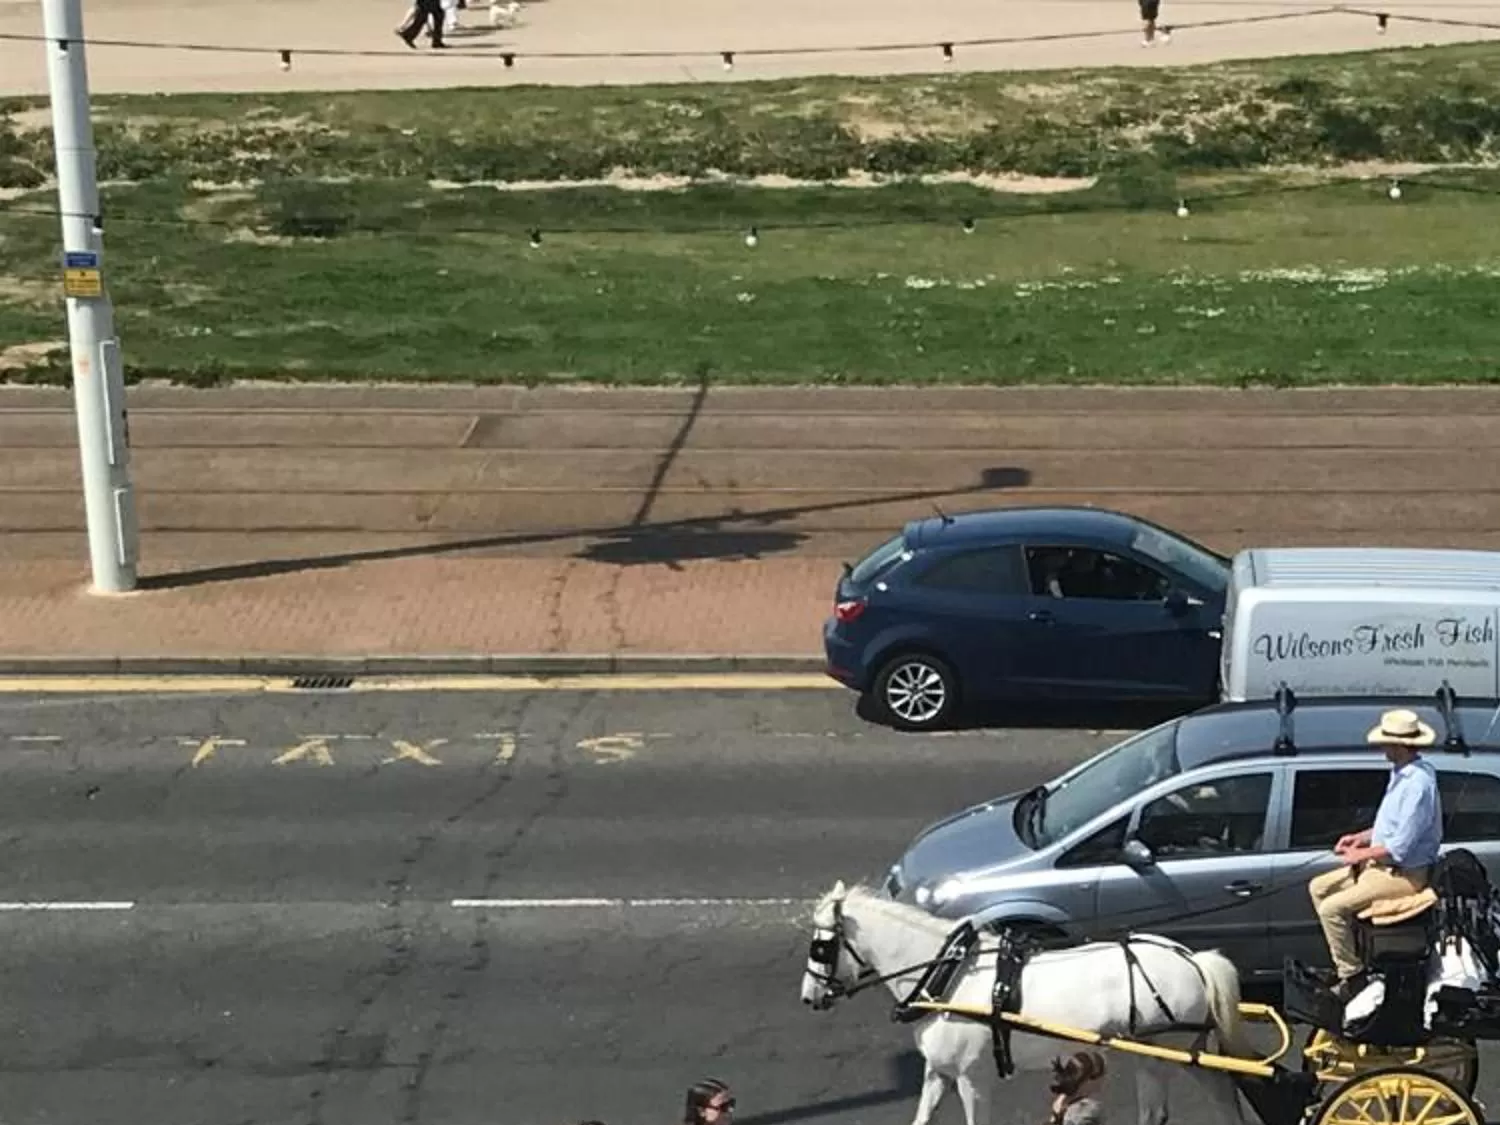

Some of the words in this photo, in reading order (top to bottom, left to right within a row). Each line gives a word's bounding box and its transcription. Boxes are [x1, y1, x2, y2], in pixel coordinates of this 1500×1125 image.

[1254, 632, 1353, 663] Wilsons
[1353, 622, 1425, 653] Fresh
[1435, 615, 1493, 646] Fish
